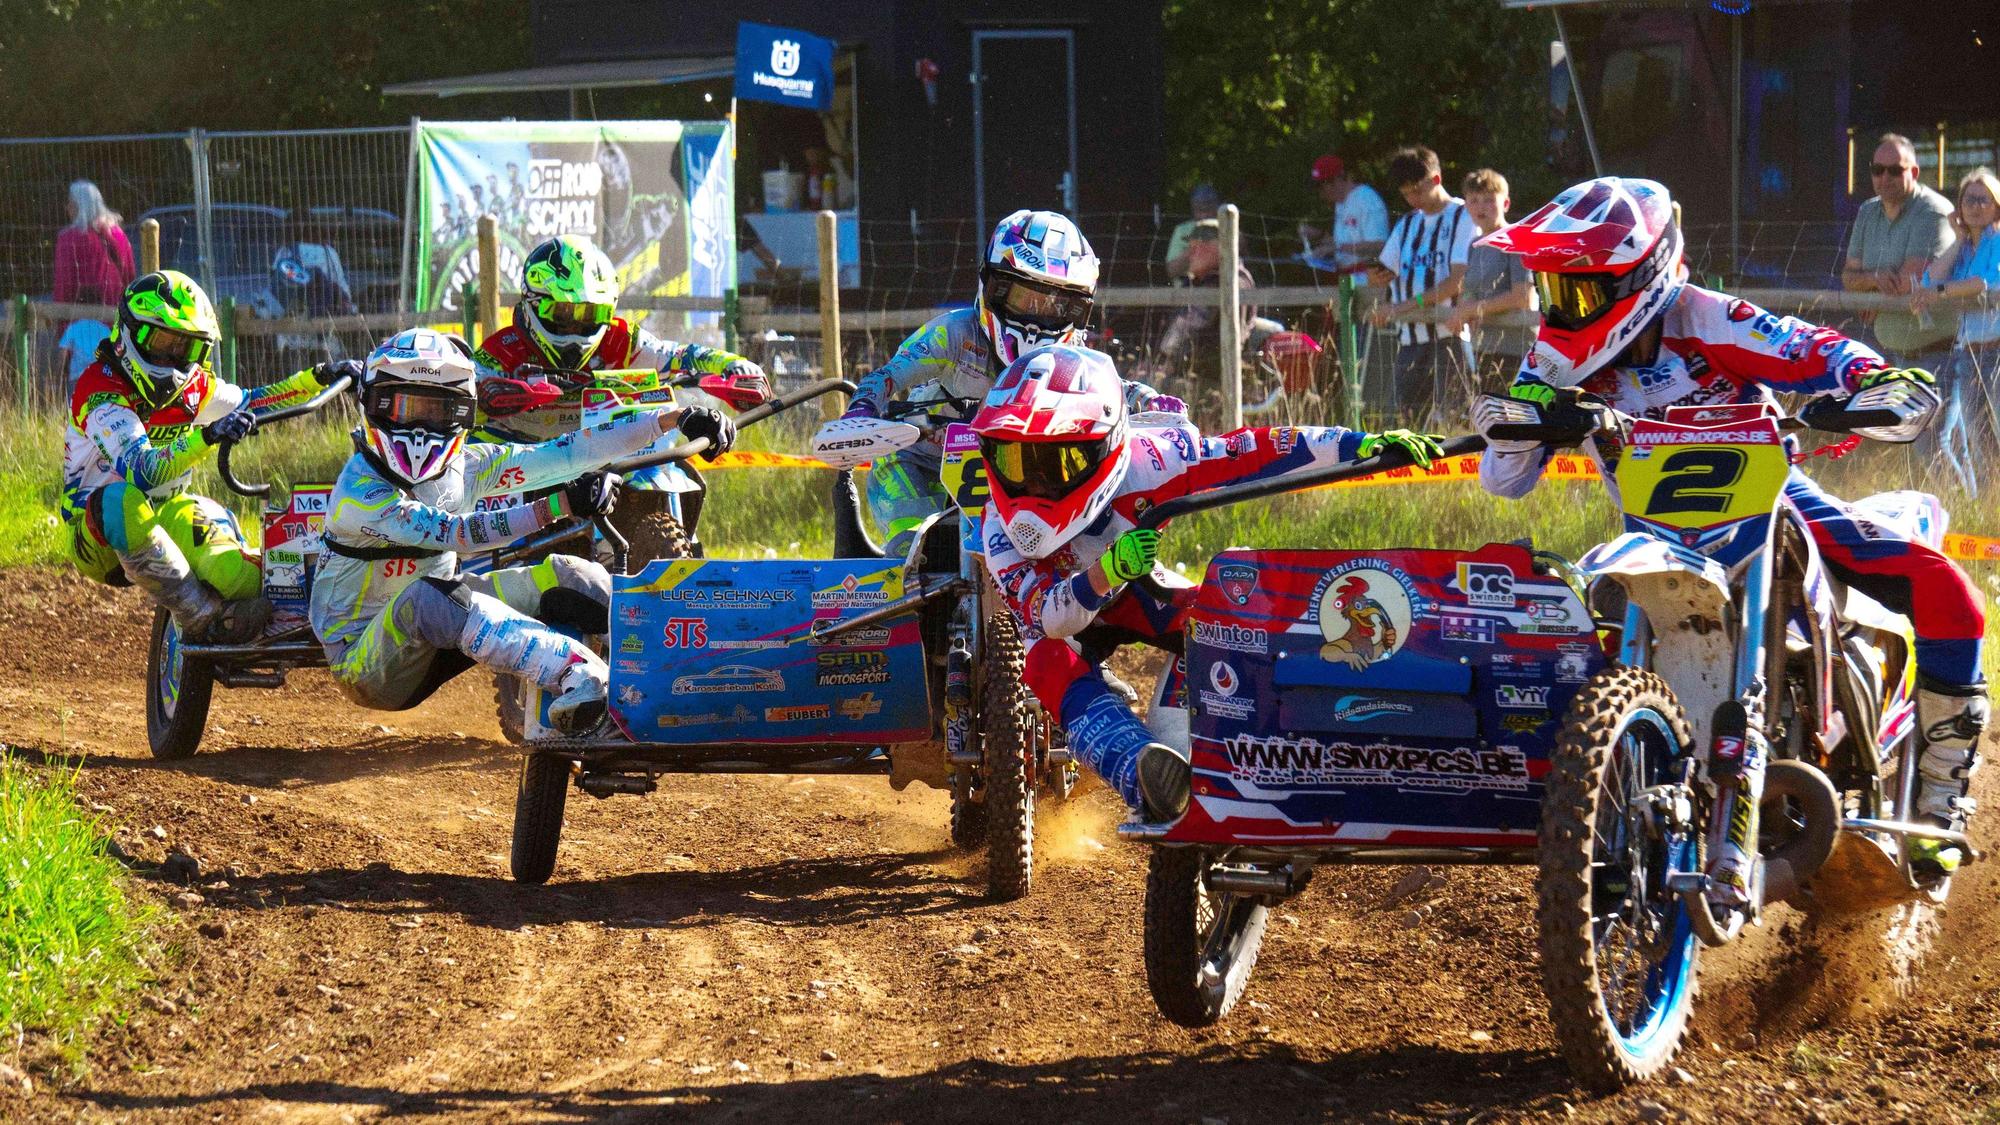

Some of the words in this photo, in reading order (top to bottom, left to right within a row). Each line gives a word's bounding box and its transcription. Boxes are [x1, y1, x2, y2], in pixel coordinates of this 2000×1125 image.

[526, 199, 598, 237] SCHOOL
[410, 366, 441, 377] AIROH
[149, 424, 191, 441] WSP
[954, 433, 976, 443] MSC
[1633, 431, 1773, 444] WWW.SMXPICS.BE
[817, 438, 874, 451] ACERBIS
[1645, 447, 1748, 516] 2
[279, 551, 301, 562] Bens
[1223, 570, 1255, 579] DAPA
[660, 589, 708, 601] LUCA
[713, 589, 795, 601] SCHNACK
[812, 592, 843, 600] MARTIN
[846, 592, 889, 600] MERWALD
[1309, 558, 1390, 621] DIENSTVERLENING
[1391, 567, 1422, 619] GIELKENS
[1470, 592, 1515, 603] swinnen
[686, 602, 713, 610] Montage
[812, 601, 836, 609] Fliesen
[663, 618, 707, 648] STS
[1195, 621, 1268, 647] swinton
[820, 671, 888, 686] MOTORSPORT
[683, 682, 753, 692] Karosseriebau
[1334, 701, 1414, 721] Kidsandsidecars
[1083, 714, 1112, 744] HDM
[1111, 731, 1140, 754] HDM
[1226, 737, 1528, 778] WWW.SMXPICS.BE
[1233, 772, 1250, 781] De
[1255, 774, 1292, 784] foto-
[1295, 776, 1315, 784] en
[1407, 778, 1440, 786] over
[1443, 778, 1528, 791] zijspannen
